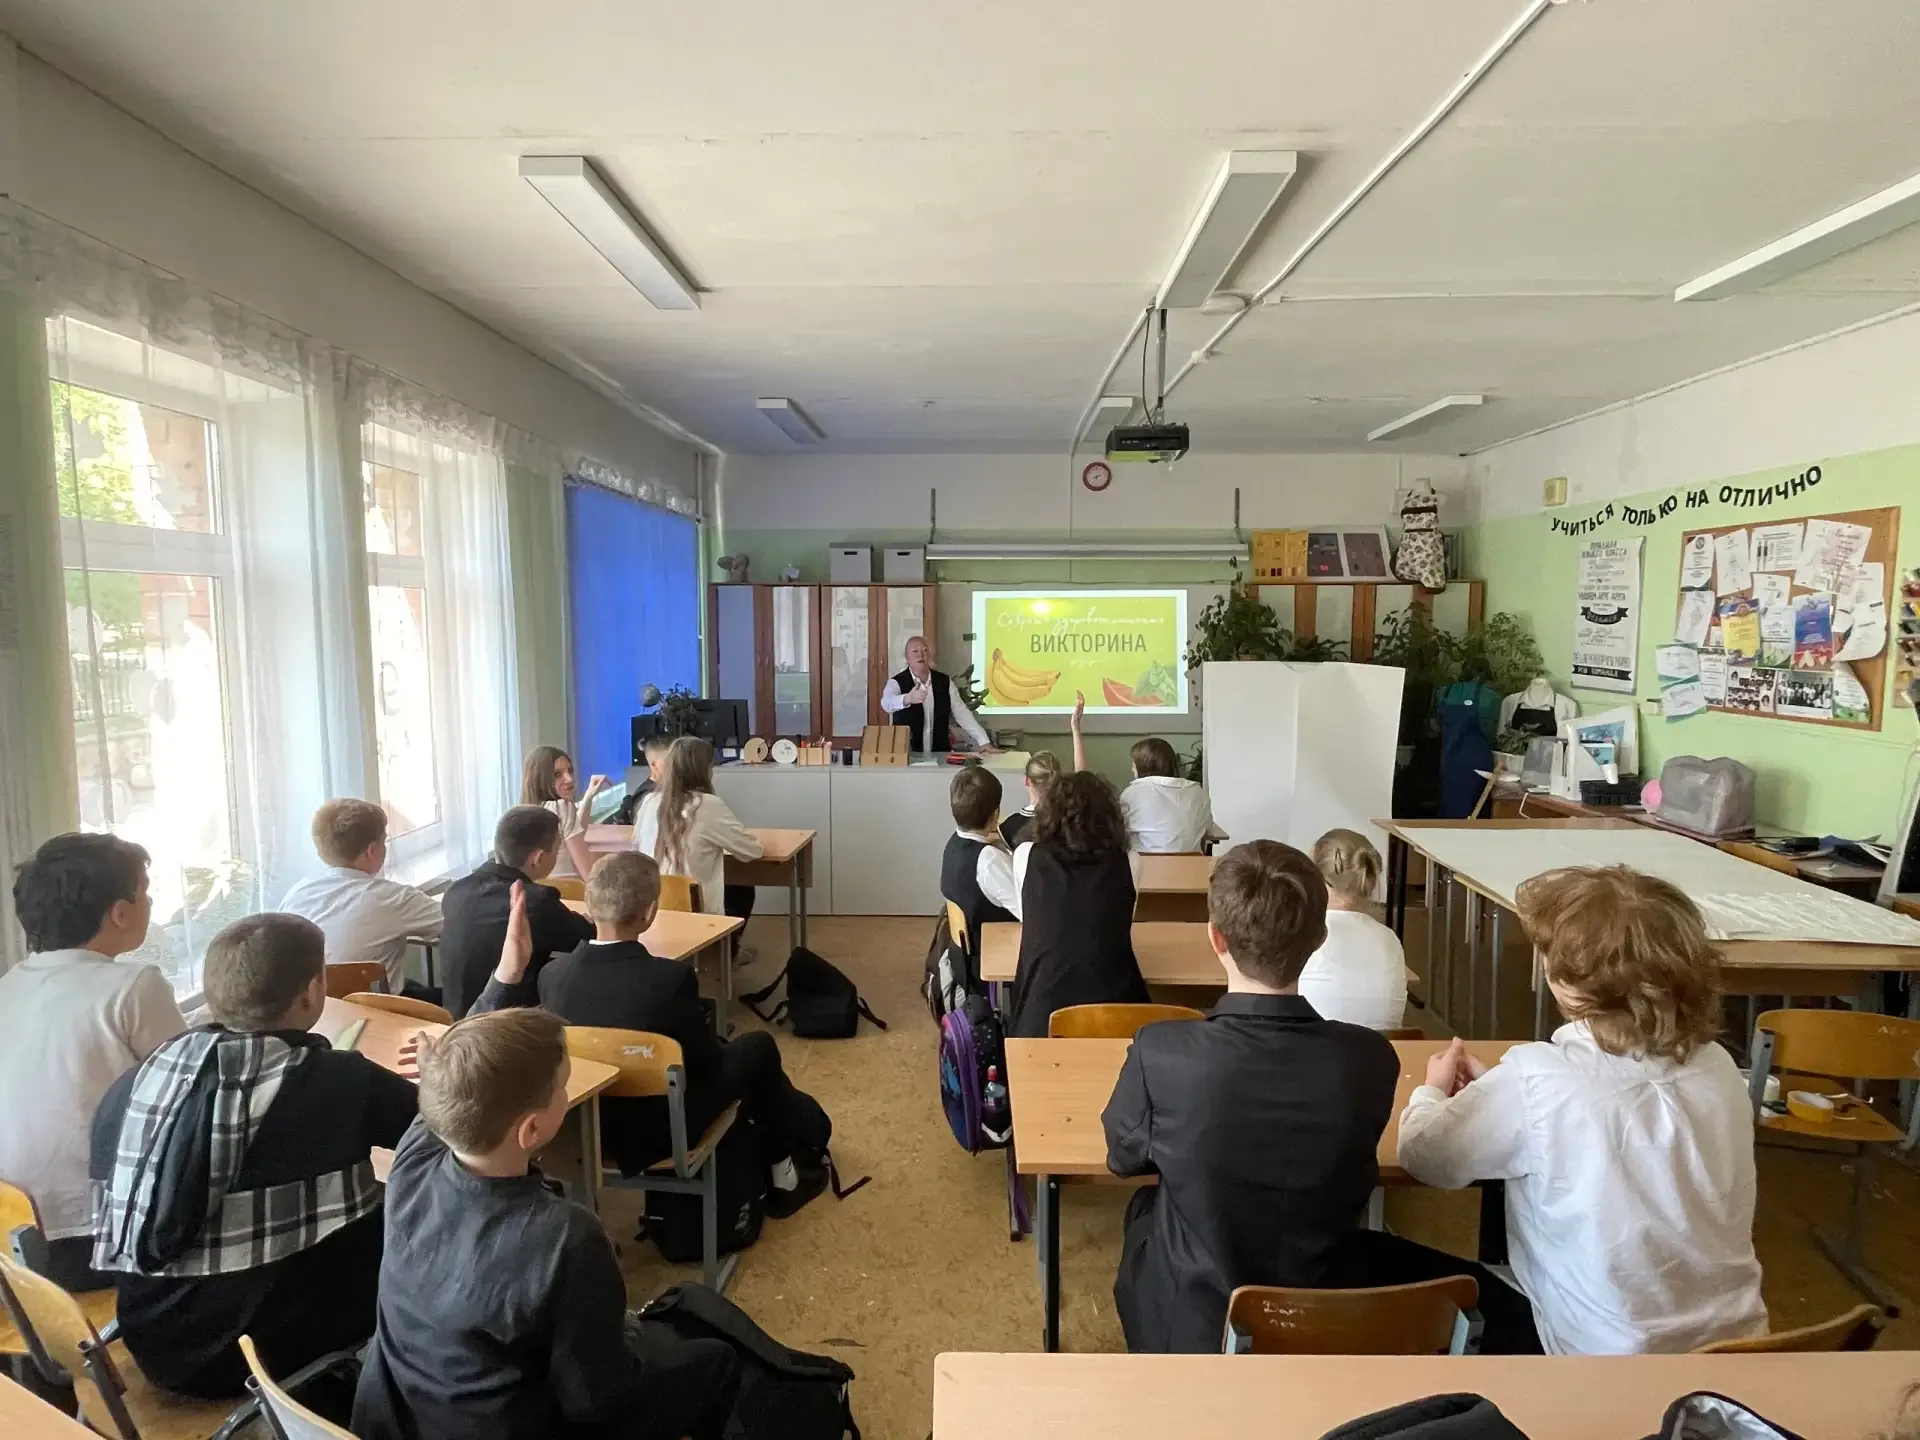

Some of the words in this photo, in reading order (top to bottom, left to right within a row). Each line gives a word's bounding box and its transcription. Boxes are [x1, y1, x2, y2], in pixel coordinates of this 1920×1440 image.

[1551, 503, 1614, 536] УЧИТЬСЯ
[1621, 495, 1677, 526] ТОЛЬКО
[1686, 491, 1709, 508] НА
[1719, 466, 1821, 507] ОТЛИЧНО
[1030, 633, 1147, 653] ВИКТОРИНА
